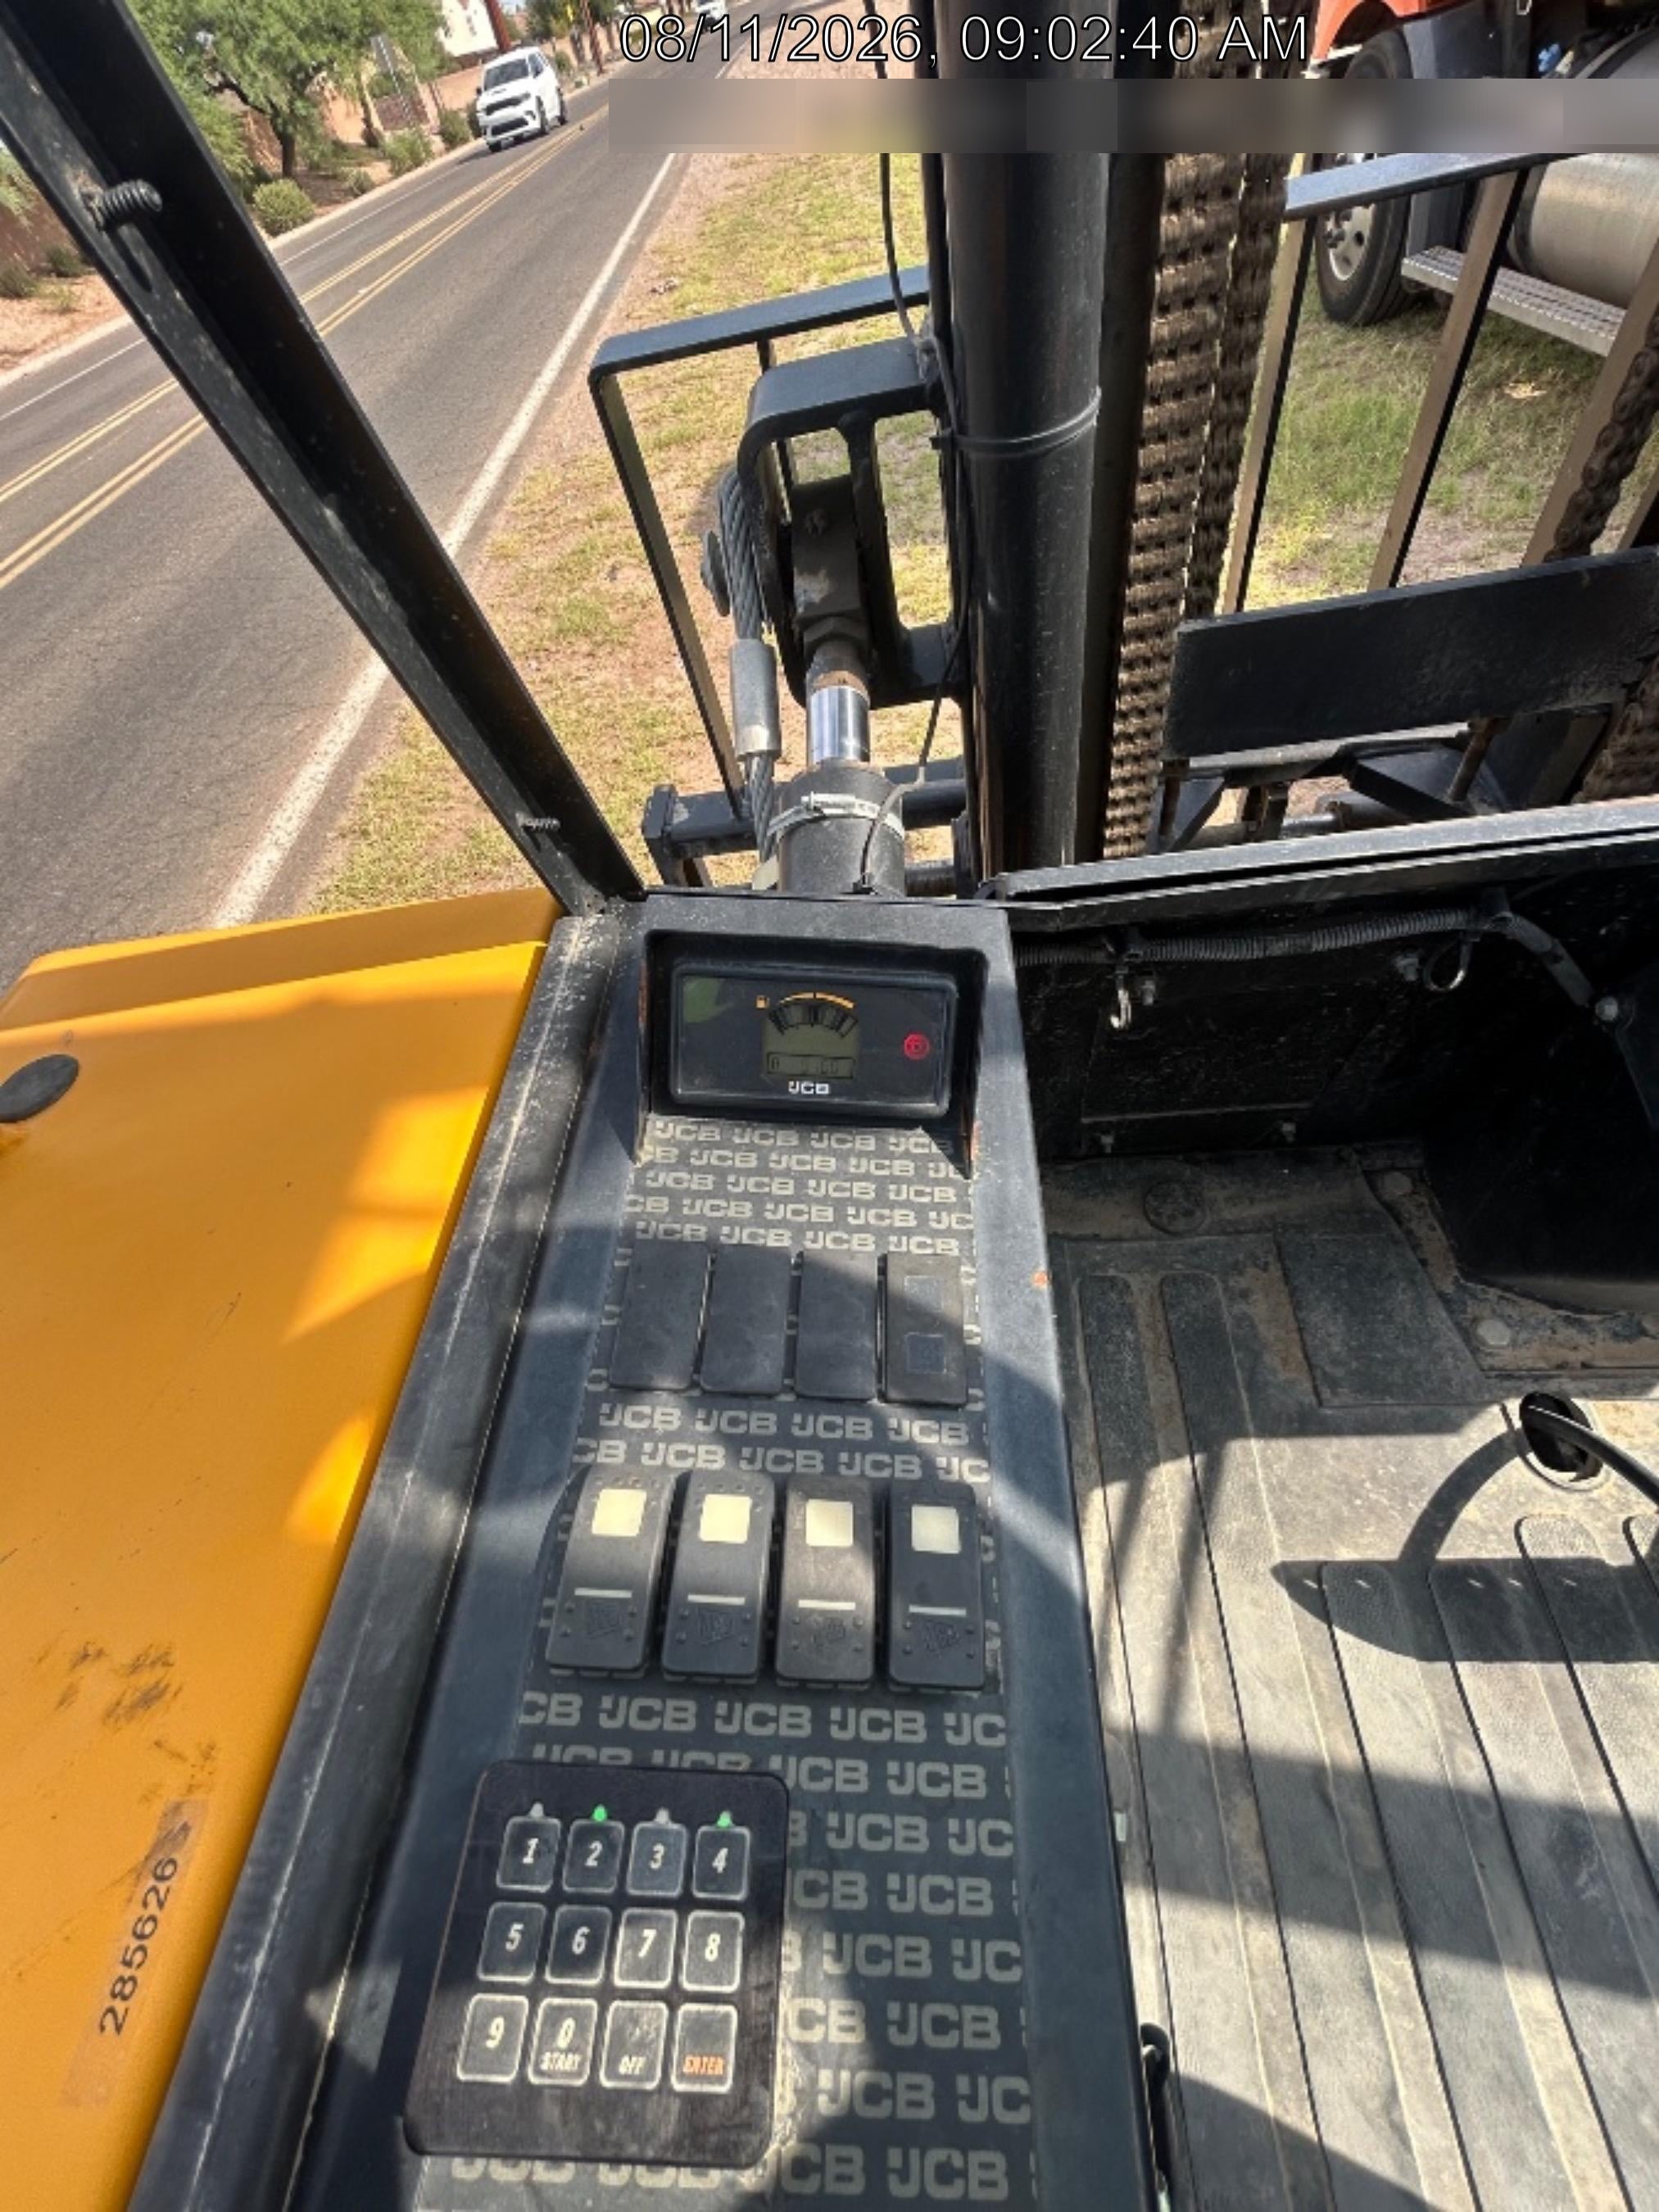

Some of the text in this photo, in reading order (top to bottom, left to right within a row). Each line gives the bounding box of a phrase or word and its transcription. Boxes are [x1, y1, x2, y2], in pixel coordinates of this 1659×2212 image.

[788, 1080, 829, 1095] JCB
[656, 1121, 721, 1141] JCB
[732, 1126, 799, 1146] JCB
[810, 1132, 876, 1151] JCB
[690, 1149, 758, 1168] JCB
[769, 1153, 836, 1172] JCB
[850, 1156, 915, 1176] JCB
[646, 1171, 957, 1203] JCB JCB JCB JCB
[624, 1194, 974, 1230] CB JCB JCB JCB JC
[636, 1221, 959, 1256] JCB JCB JCB JCB
[599, 1403, 969, 1445] JCB JCB JCB JCB
[573, 1438, 990, 1483] CB JCB JCB JCB JC
[519, 1691, 1006, 1747] CB JCB JCB JCB JC
[887, 1761, 986, 1798] JCB
[826, 1813, 930, 1852] JCB
[948, 1818, 1013, 1856] JC
[522, 1838, 729, 1872] 1 2 3 4
[790, 1869, 993, 1916] CB JCB
[98, 1856, 178, 2036] 285626
[505, 1924, 721, 1961] 5 6 7 8
[822, 1933, 931, 1978] JCB
[950, 1938, 1022, 1983] JC
[486, 2018, 575, 2047] 9 0
[787, 1997, 1001, 2049] CB JCB
[540, 2051, 724, 2075] START OFF ENTER
[818, 2069, 935, 2120] JCB
[956, 2074, 1031, 2124] JC
[887, 2147, 1008, 2201] JCB
